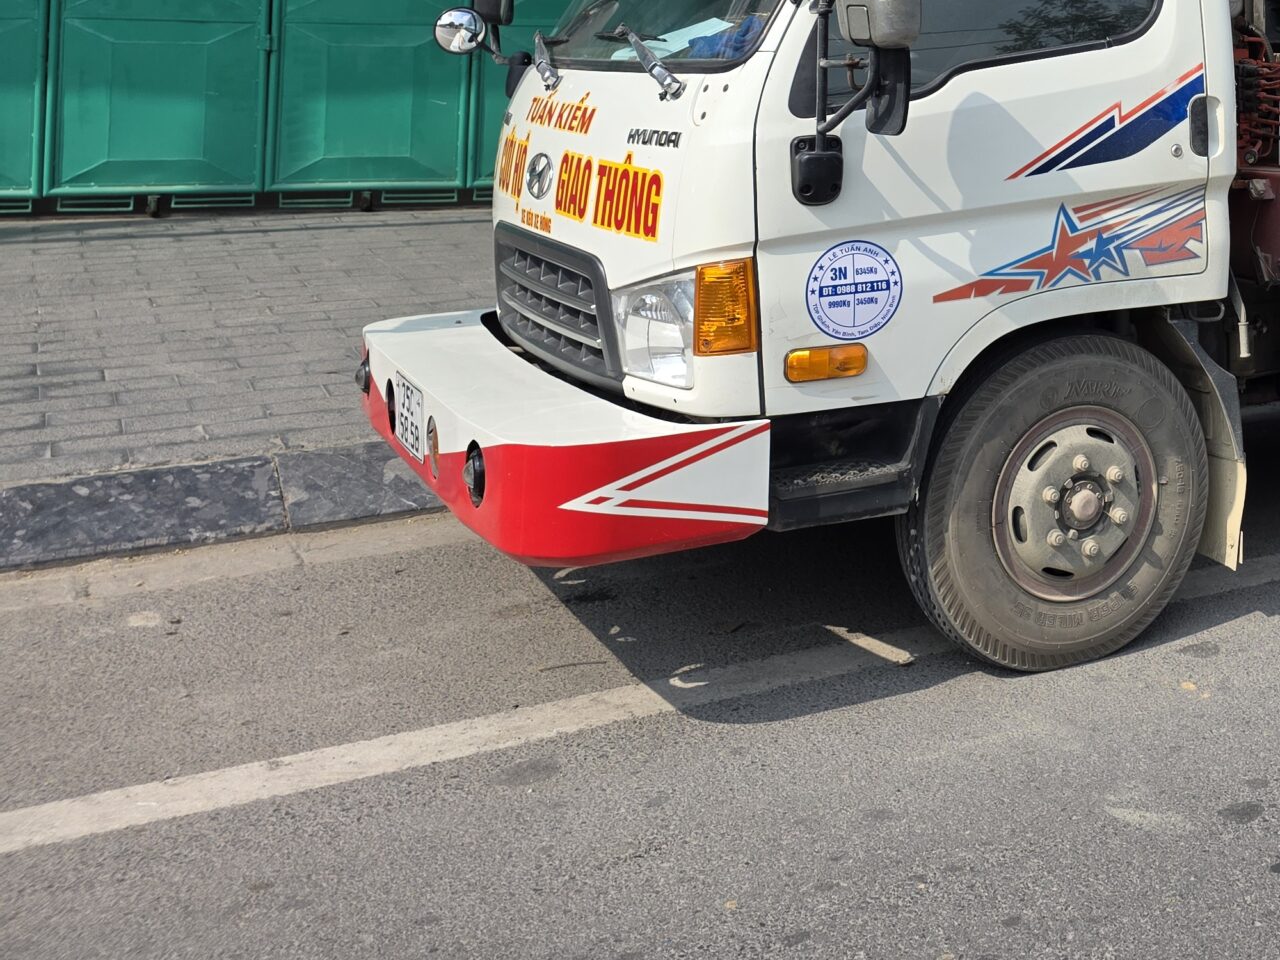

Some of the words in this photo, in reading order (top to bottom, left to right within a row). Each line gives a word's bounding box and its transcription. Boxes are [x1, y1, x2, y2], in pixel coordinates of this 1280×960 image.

[627, 128, 682, 148] HYUNDAI
[555, 151, 593, 220] GIAO
[592, 152, 664, 240] THÔNG
[863, 247, 879, 257] ANH
[830, 266, 848, 281] 3N
[822, 287, 835, 296] ĐT:
[836, 284, 856, 294] 0988
[857, 282, 872, 292] 812
[873, 280, 887, 290] 116
